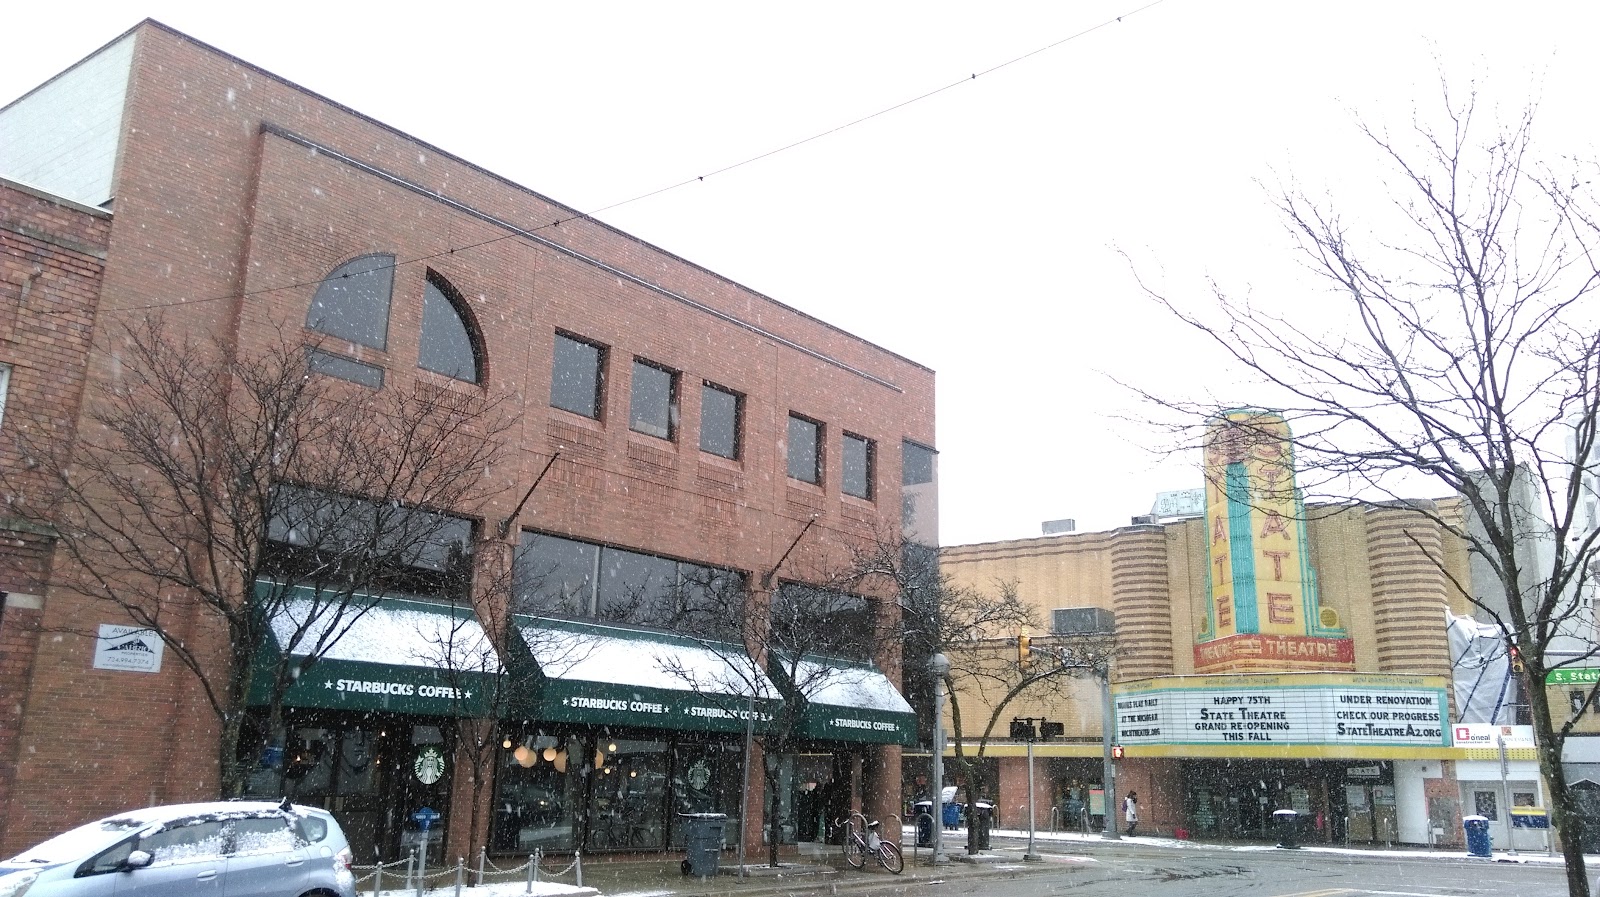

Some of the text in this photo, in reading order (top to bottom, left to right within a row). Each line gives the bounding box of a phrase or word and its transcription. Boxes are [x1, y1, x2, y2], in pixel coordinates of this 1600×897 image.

[1256, 428, 1295, 624] STATE
[1266, 640, 1338, 657] THEATRE
[1555, 672, 1567, 681] S.
[336, 679, 462, 699] STARBUCKS COFFEE
[571, 697, 663, 714] STARBUCKS COFFEE
[1213, 696, 1271, 704] HAPPY 75TH
[1340, 695, 1432, 705] UNDER RENOVATION
[690, 706, 738, 719] STARBUCKS
[1200, 707, 1286, 720] STATE THEATRE
[1337, 711, 1440, 721] CHECK OUR PROGRESS
[835, 718, 895, 732] STARBUCKS COFFEE
[1194, 721, 1290, 731] GRAND RE-OPENING
[1223, 732, 1272, 741] THIS FALL
